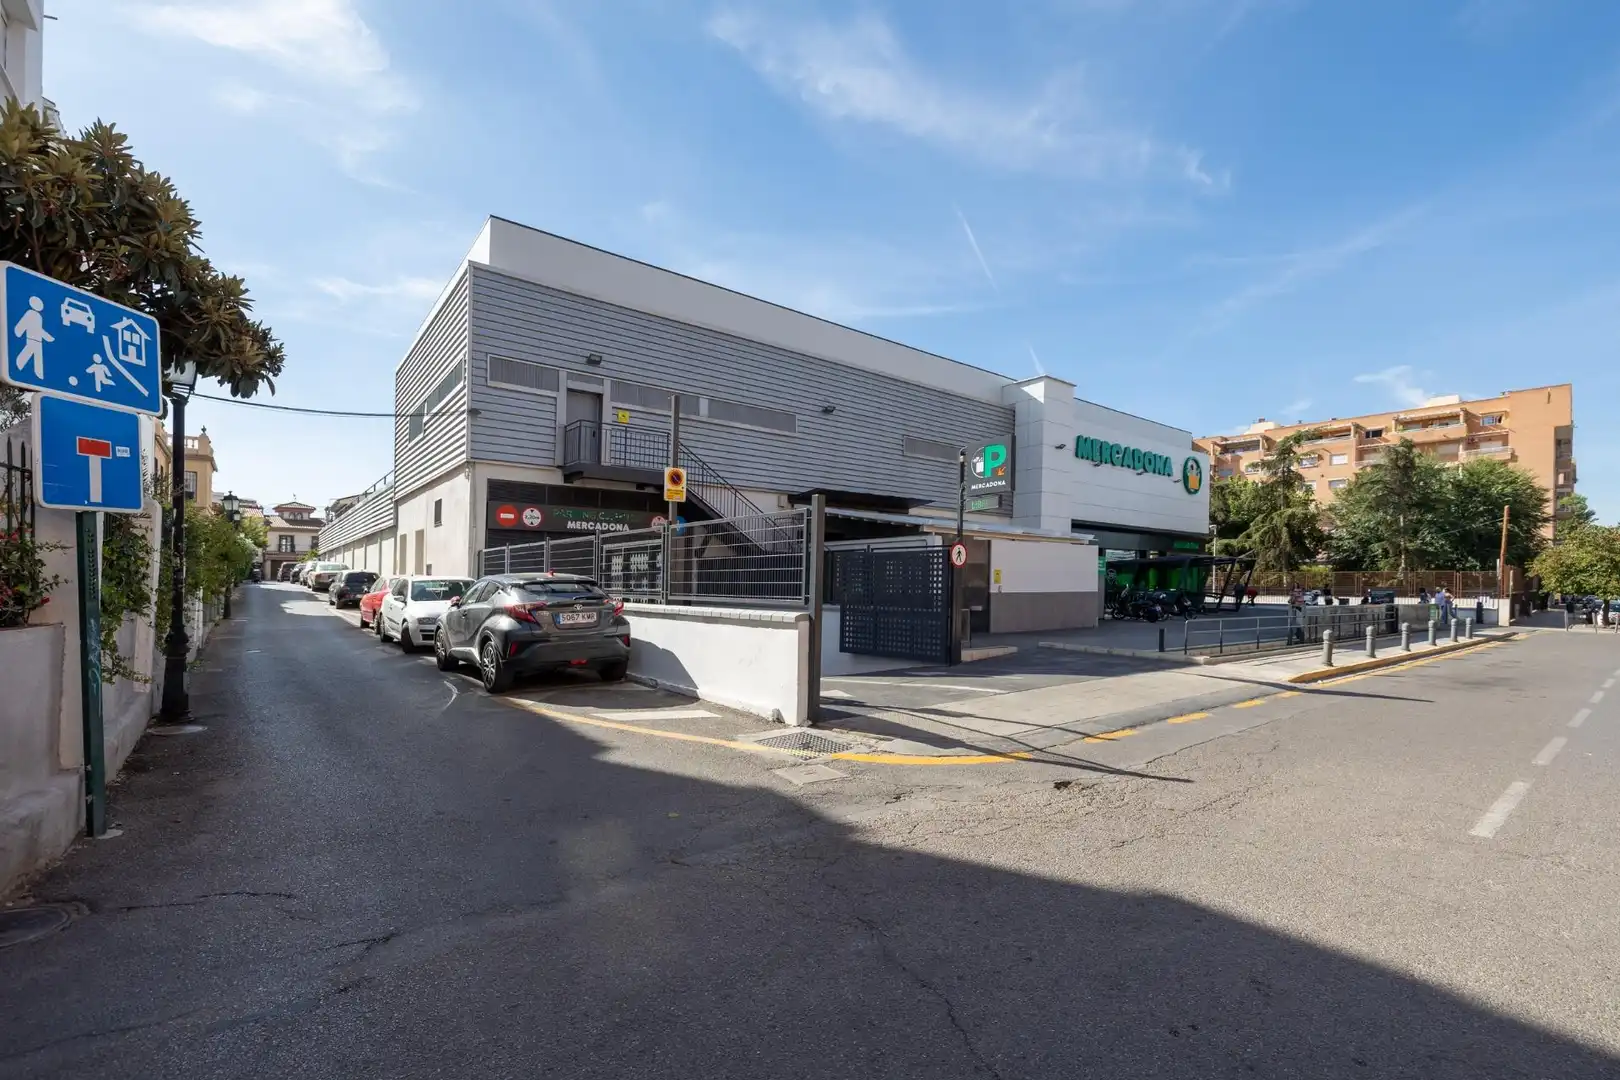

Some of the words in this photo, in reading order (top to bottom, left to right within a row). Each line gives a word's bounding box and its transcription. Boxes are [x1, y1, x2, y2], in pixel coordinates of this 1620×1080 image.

[984, 444, 1007, 478] P
[1074, 434, 1173, 477] MERCADONA
[971, 480, 1006, 490] MERCADONA
[567, 520, 630, 532] MERCADONA
